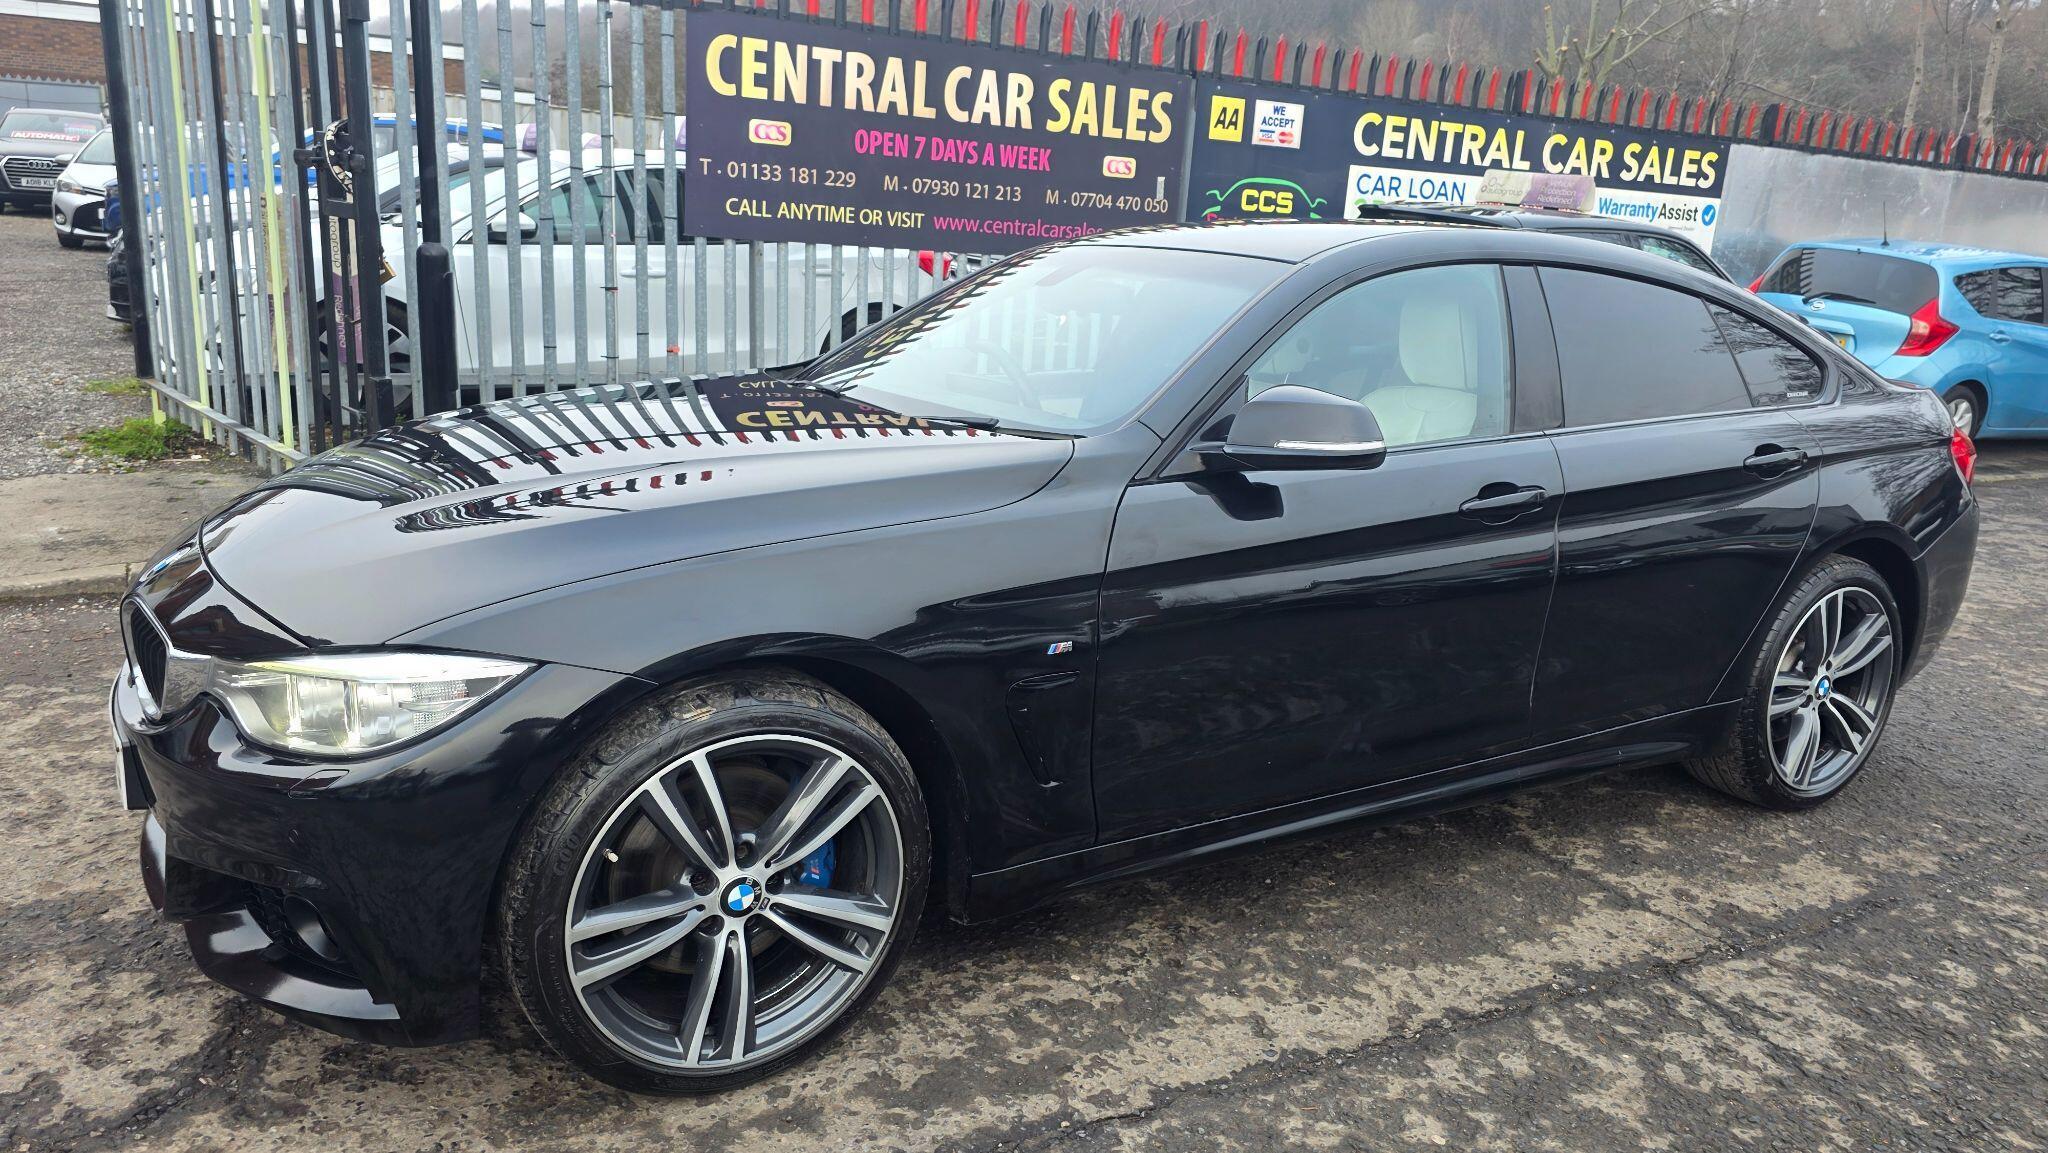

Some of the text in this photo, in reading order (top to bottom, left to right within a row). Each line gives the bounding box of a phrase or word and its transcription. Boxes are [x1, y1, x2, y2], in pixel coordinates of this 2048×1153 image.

[706, 33, 1174, 144] CENTRAL CAR SALES
[1214, 106, 1240, 131] AA
[1261, 116, 1295, 129] ACCEPT
[1273, 105, 1287, 116] WE
[854, 128, 1052, 172] OPEN 7 DAYS A WEEK
[1353, 112, 1719, 189] CENTRAL CAR SALES
[699, 158, 857, 188] T 01133 181 229
[883, 175, 1022, 202] M 07930 121 213
[1046, 190, 1169, 213] M 07704 470 050
[1241, 188, 1294, 214] CCS
[1356, 173, 1467, 203] CAR LOAN
[725, 198, 772, 218] CALL
[777, 201, 856, 224] ANYTIME
[859, 209, 883, 226] OR
[887, 211, 925, 229] VISIT
